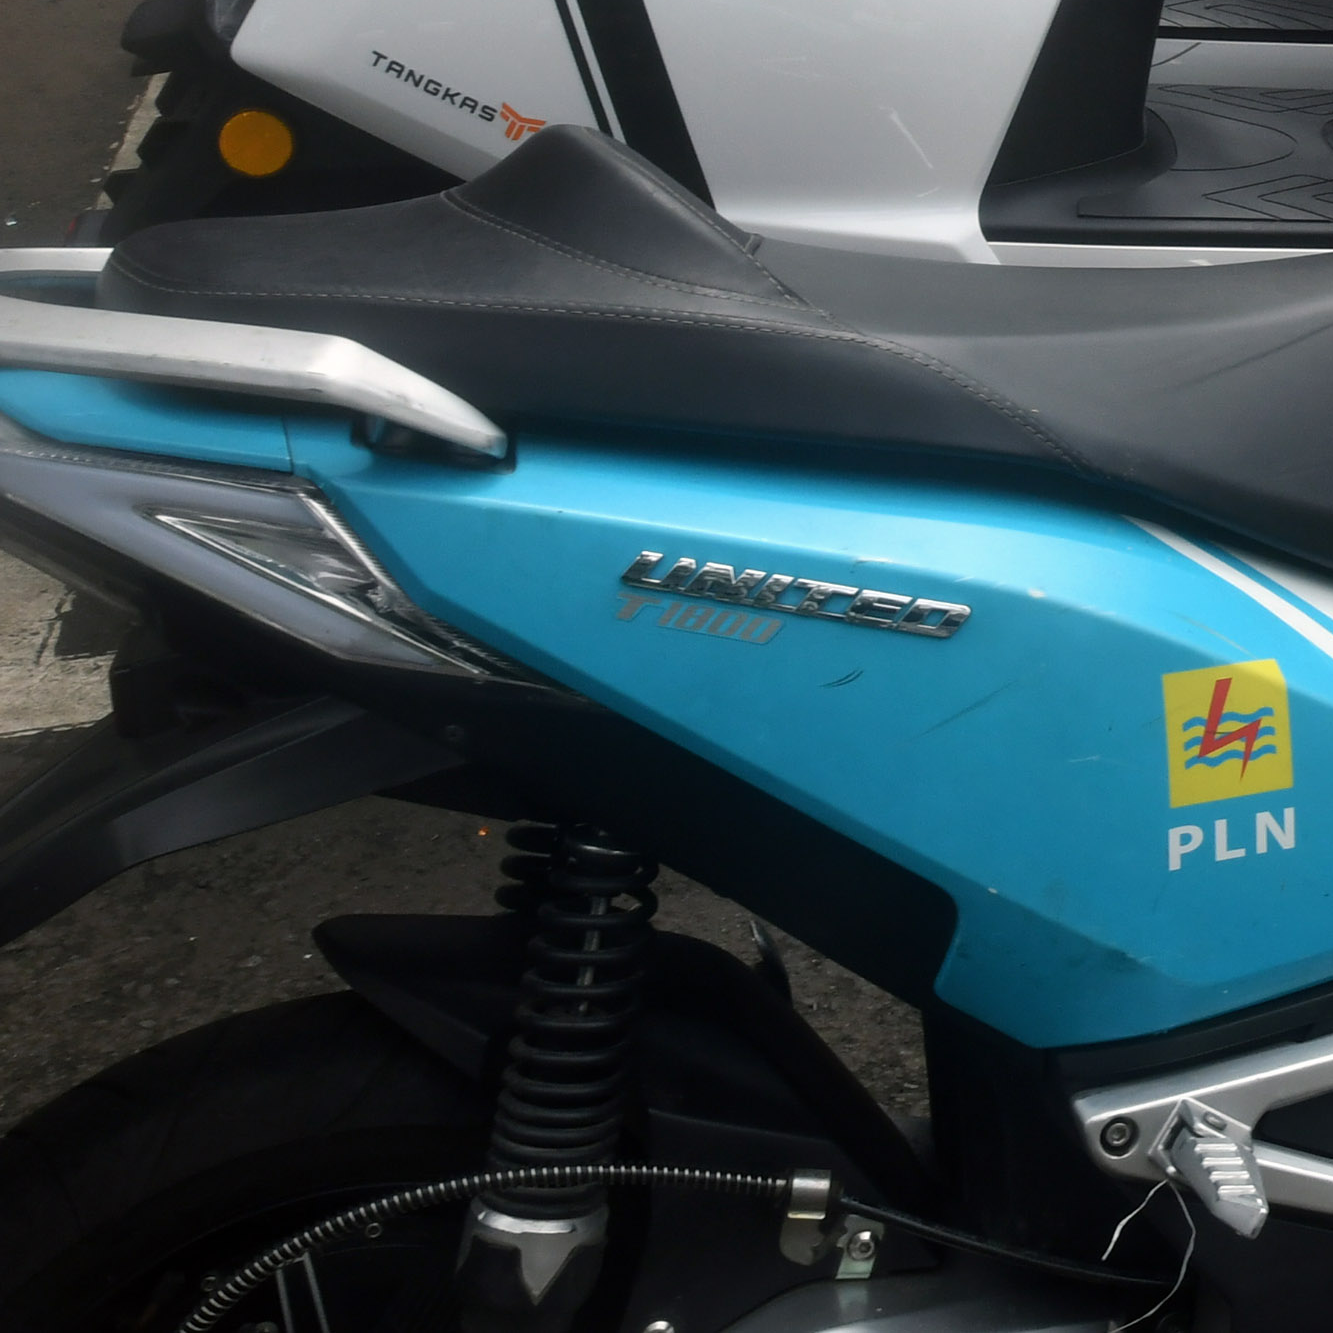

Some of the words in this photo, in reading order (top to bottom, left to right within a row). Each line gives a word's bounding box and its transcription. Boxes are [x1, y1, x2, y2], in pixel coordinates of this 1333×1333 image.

[372, 50, 498, 123] TANGKAS
[619, 550, 972, 639] UNITED
[1168, 806, 1296, 872] PLN
